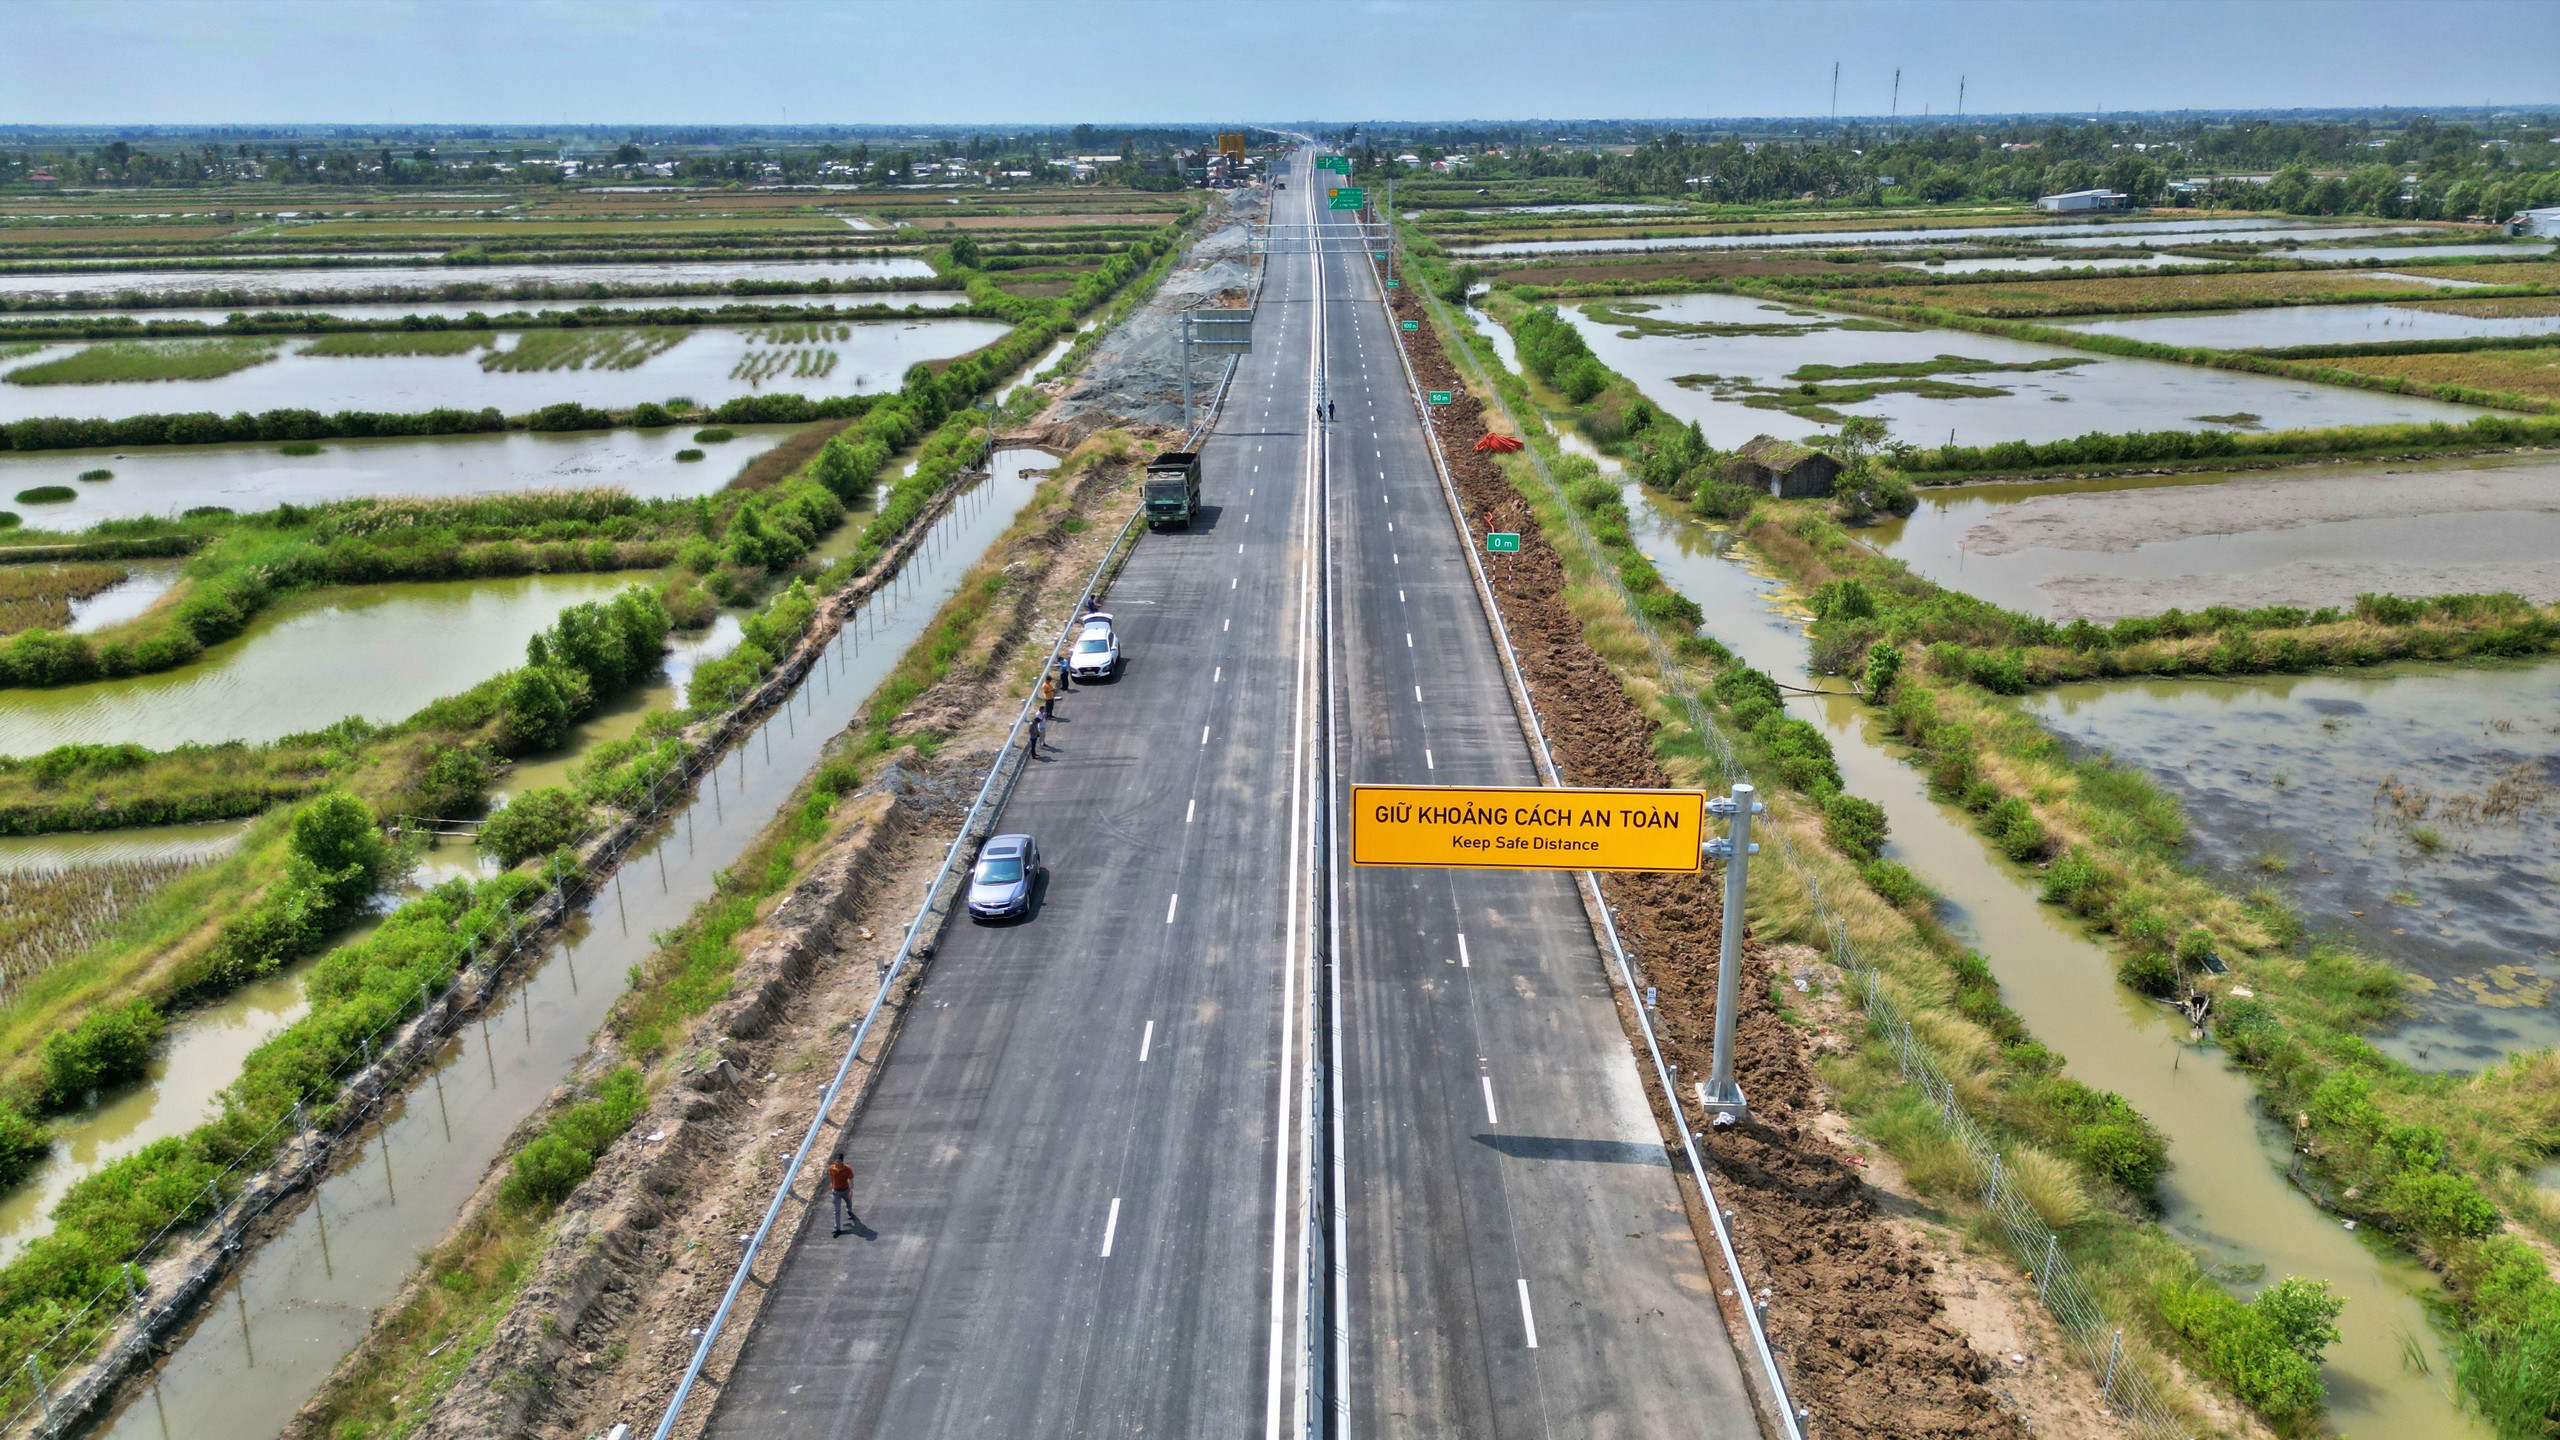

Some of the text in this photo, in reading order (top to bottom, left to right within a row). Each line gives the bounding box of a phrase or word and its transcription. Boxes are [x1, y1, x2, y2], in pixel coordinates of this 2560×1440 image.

[1494, 538, 1500, 548] 0
[1375, 801, 1680, 829] GIỮ KHOẢNG CÁCH AN TOÀN
[1452, 835, 1600, 852] Keep Safe Distance
